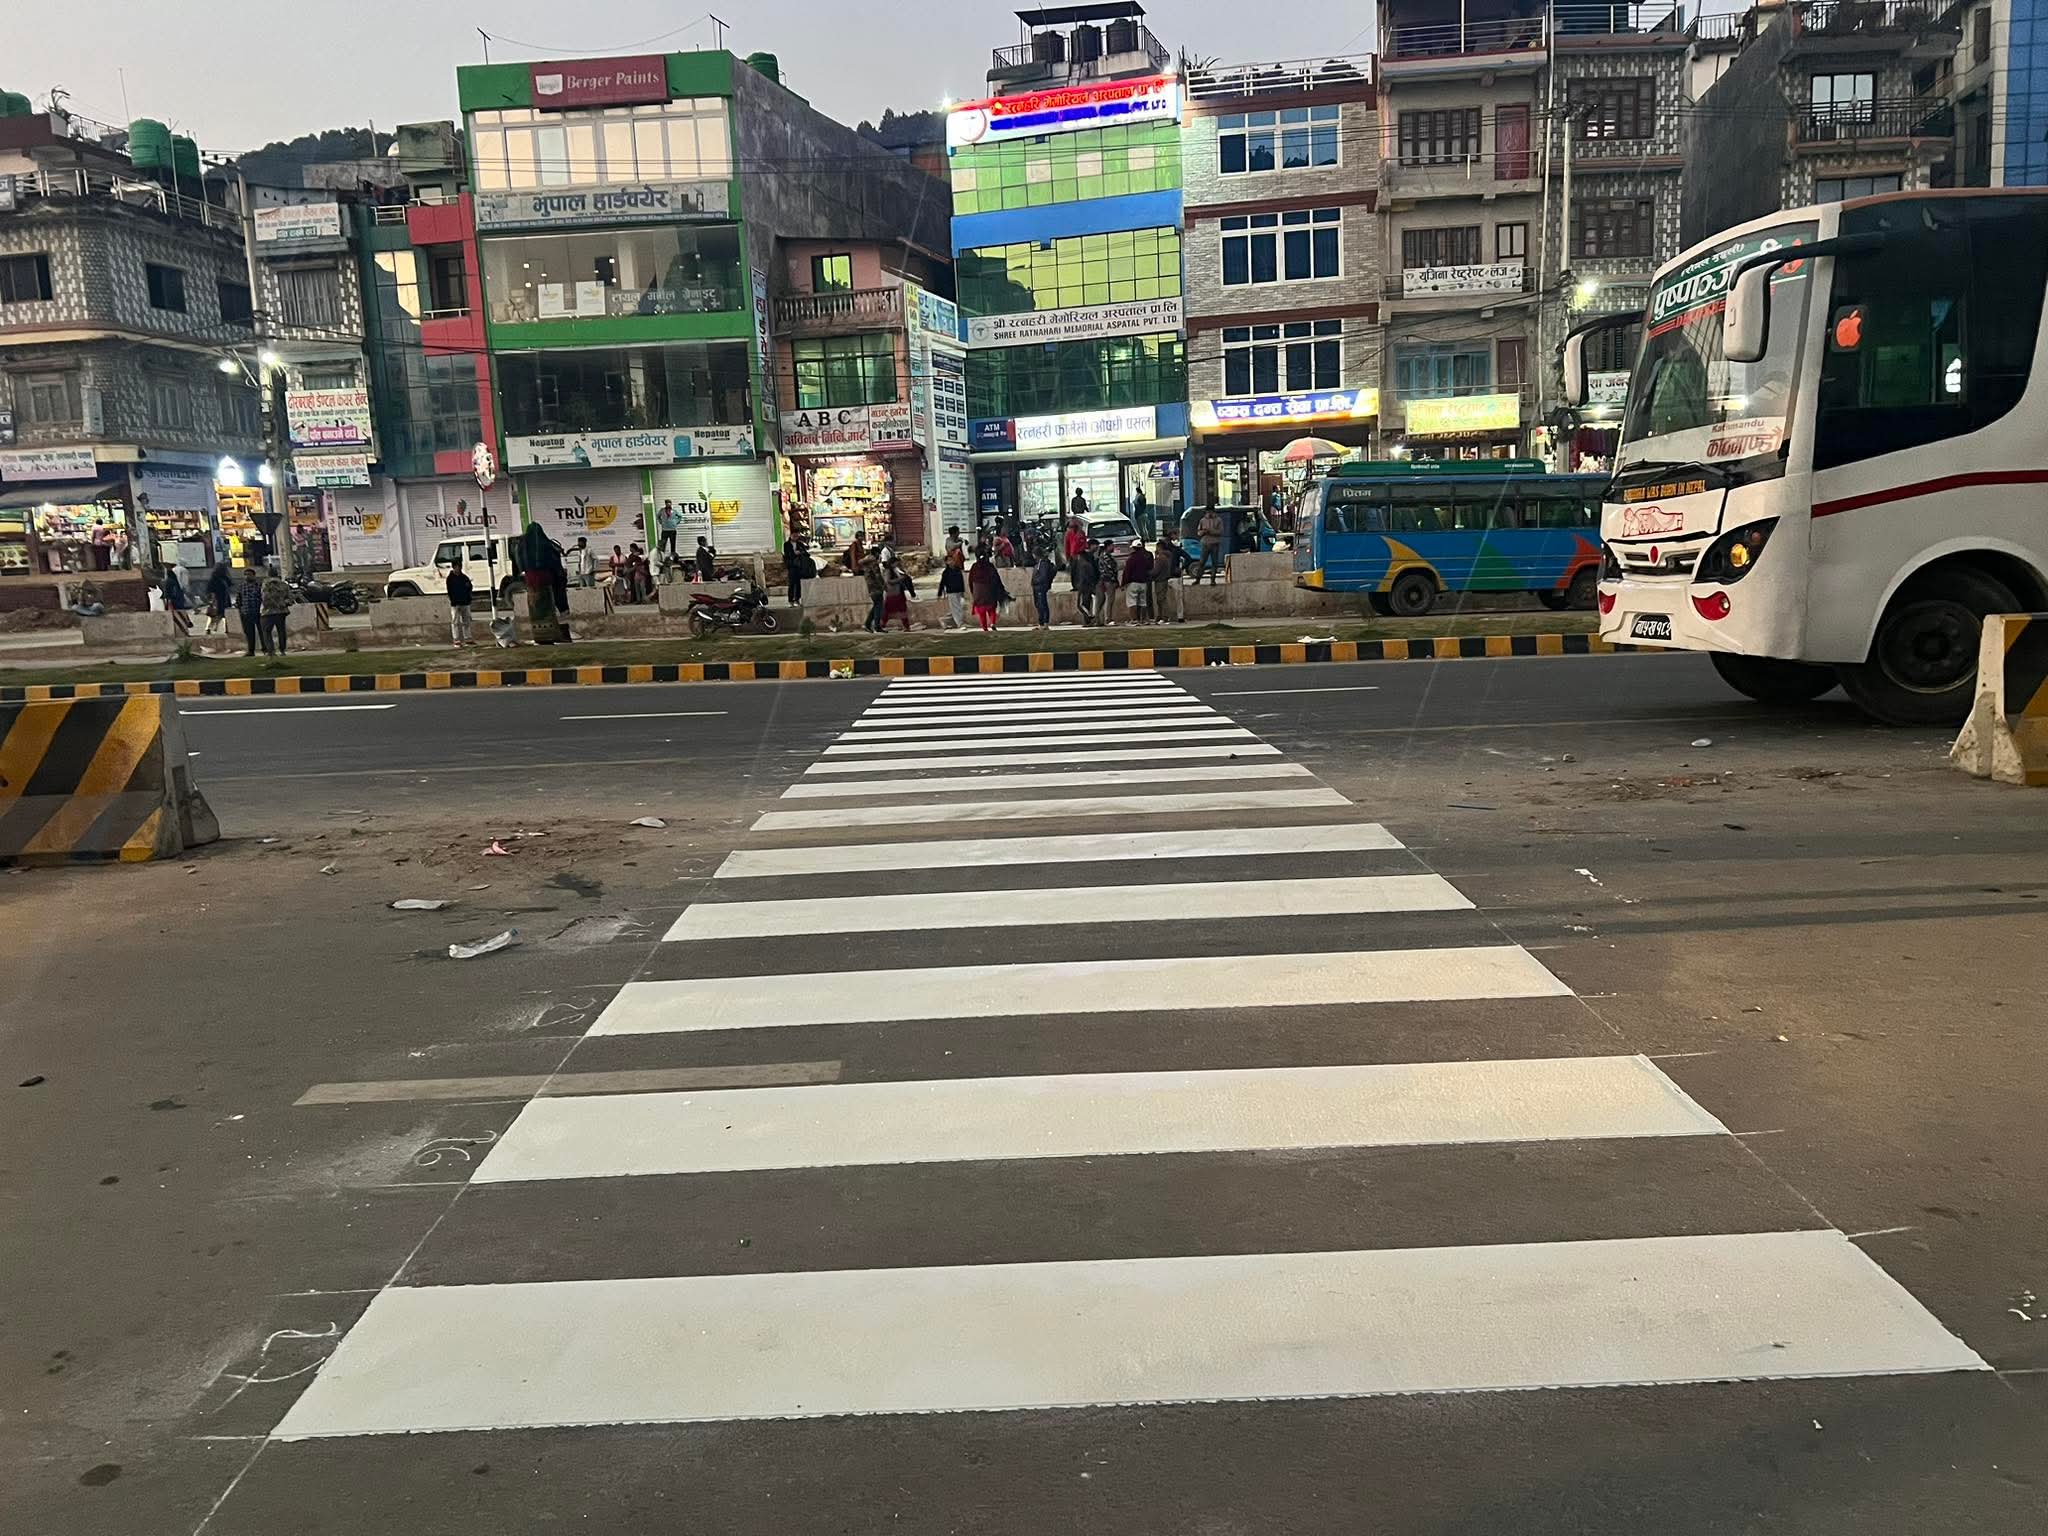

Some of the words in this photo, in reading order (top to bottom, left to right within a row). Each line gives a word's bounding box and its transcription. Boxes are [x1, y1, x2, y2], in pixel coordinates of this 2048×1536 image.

[567, 75, 611, 91] Berger
[616, 70, 660, 85] Paints
[994, 330, 1017, 341] SHREE
[1019, 327, 1061, 338] RATNAHARI
[1064, 323, 1104, 335] MEMORIAL
[1107, 319, 1140, 331] ASPATAL
[984, 423, 1000, 432] ATM
[694, 430, 730, 439] Nepatop
[529, 438, 565, 448] Nepatop
[555, 506, 613, 519] TRUPLY
[339, 514, 382, 527] TRUPLY
